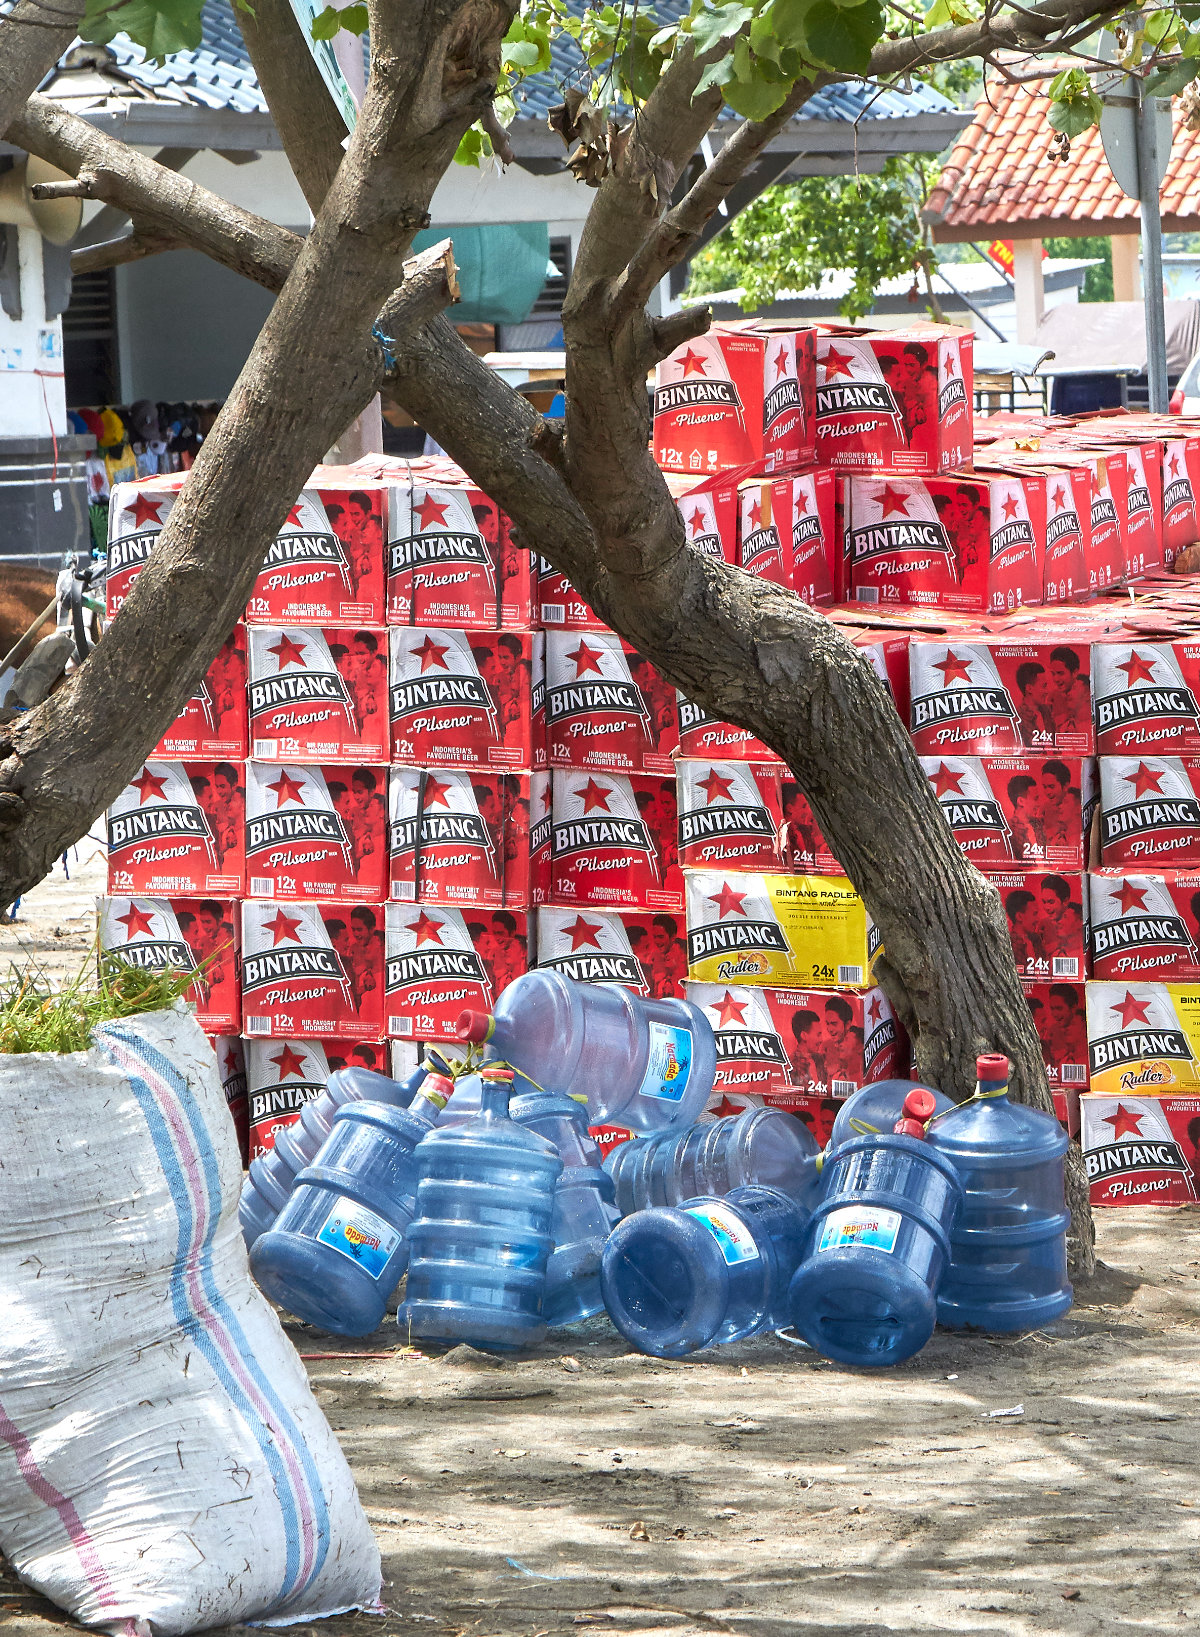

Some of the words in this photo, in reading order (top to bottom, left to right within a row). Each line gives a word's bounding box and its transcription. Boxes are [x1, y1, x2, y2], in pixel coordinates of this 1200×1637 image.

[658, 384, 730, 409] BINTANG
[817, 388, 885, 410] NTANG
[677, 412, 726, 427] Pilsener
[817, 420, 878, 438] Pilsener
[661, 449, 682, 462] 12x
[855, 528, 938, 556] BINTANG
[992, 525, 1029, 555] BINTANG
[111, 537, 157, 567] BINT
[392, 537, 478, 569] BINTANG
[875, 560, 931, 576] Pilsener
[269, 571, 327, 591] Pilsener
[414, 571, 470, 589] Pilsener
[882, 585, 900, 598] 12x
[251, 599, 269, 611] 12x
[392, 597, 411, 610] 12x
[252, 677, 337, 708] BINTANG
[393, 681, 480, 712] BINTANG
[551, 686, 632, 717] BINTANG
[915, 693, 1002, 726] BINTANG
[1099, 692, 1186, 726] BINTANG
[273, 710, 331, 730] Pilsener
[413, 714, 472, 733] Pilsener
[570, 721, 628, 737] Pilsener
[280, 738, 299, 750] 12x
[937, 725, 999, 745] Pilsener
[1122, 727, 1185, 745] Pilsener
[394, 740, 413, 753] 12x
[112, 811, 198, 845] BINTANG
[682, 811, 763, 840] BINTANG
[1108, 805, 1196, 836] BINTANG
[250, 816, 335, 847] BINTANG
[556, 822, 639, 850] BINTANG
[133, 844, 191, 865] Pilsener
[702, 843, 761, 861] Pilsener
[1023, 844, 1043, 855] 24x
[1131, 836, 1195, 856] Pilsener
[270, 850, 328, 868] Pilsener
[576, 857, 633, 872] Pilsener
[114, 871, 134, 885] 12x
[277, 876, 295, 889] 12x
[420, 880, 438, 893] 12x
[557, 879, 576, 892] 12x
[776, 890, 817, 898] BINTANG
[821, 891, 859, 899] RADLER
[692, 926, 777, 956] BINTANG
[1096, 919, 1178, 950] BINTANG
[245, 953, 333, 984] BINTANG
[388, 956, 474, 985] BINTANG
[717, 960, 760, 979] Radler
[812, 965, 835, 978] 24x
[1026, 958, 1049, 971] 24x
[1118, 954, 1177, 973] Pilsener
[266, 988, 326, 1007] Pilsener
[408, 988, 467, 1007] Pilsener
[864, 1024, 893, 1065] BINTANG
[1094, 1034, 1181, 1066] BINTANG
[713, 1070, 770, 1086] Pilsener
[808, 1081, 828, 1093] 24x
[1121, 1071, 1164, 1090] Radler
[1086, 1146, 1172, 1176] BINTANG
[1109, 1178, 1171, 1198] Pilsener
